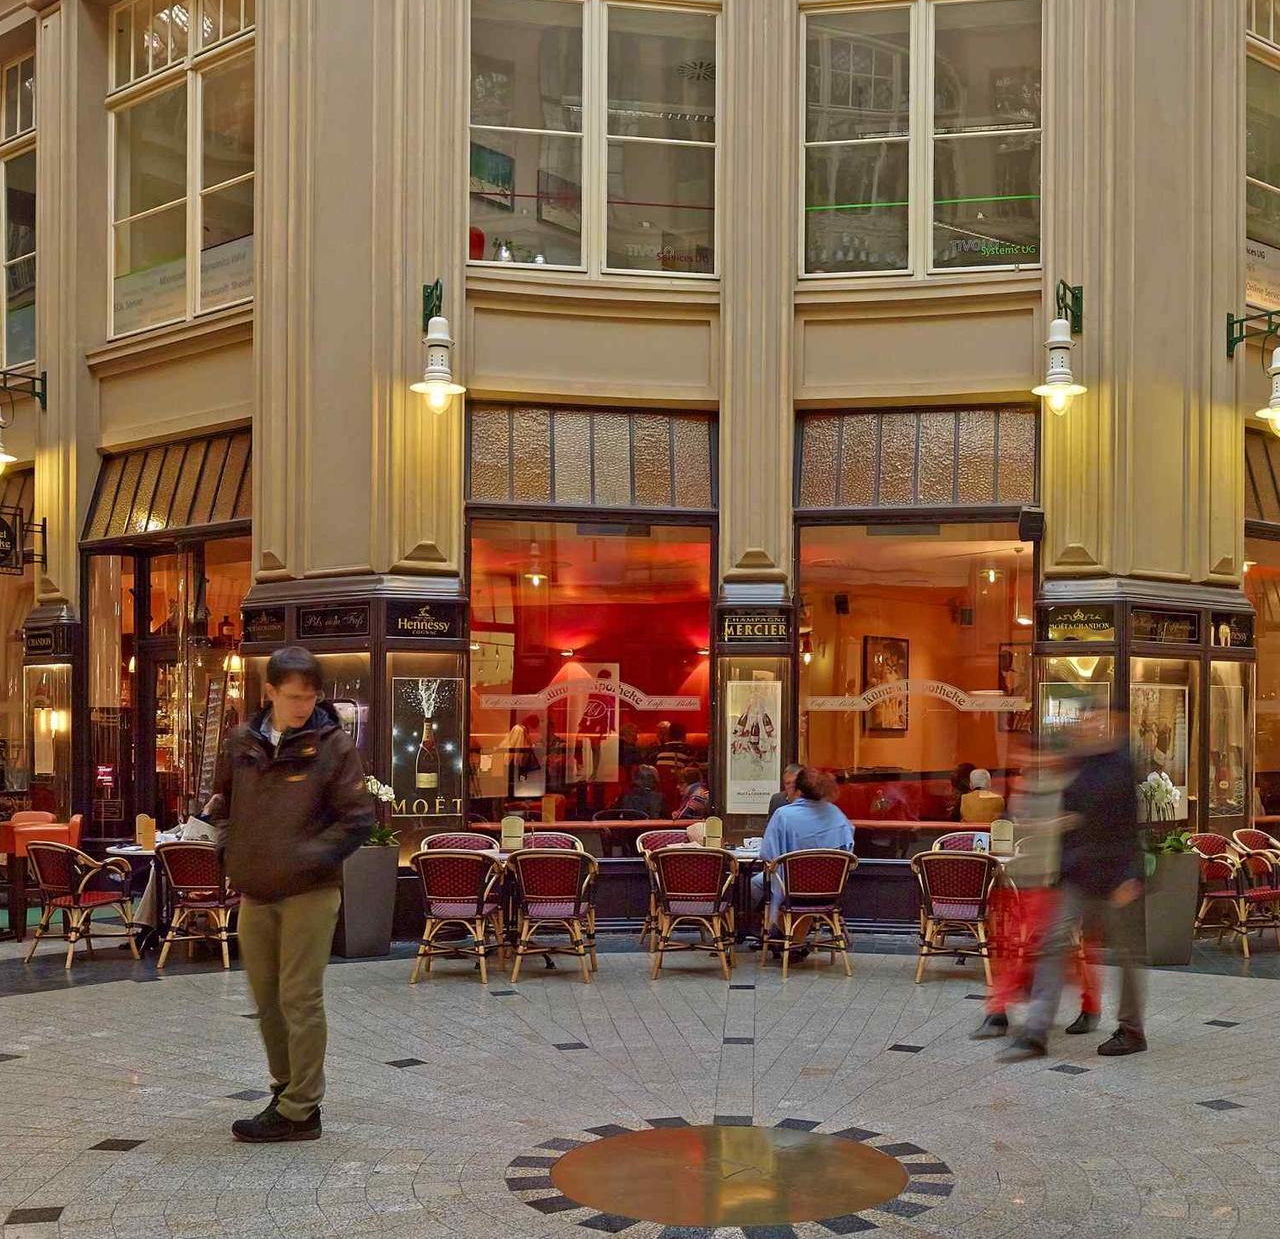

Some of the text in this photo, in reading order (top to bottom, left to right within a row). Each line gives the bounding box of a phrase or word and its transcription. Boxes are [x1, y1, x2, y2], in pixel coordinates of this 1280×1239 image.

[981, 245, 1036, 257] Systems UG
[398, 618, 450, 632] Hennessy
[724, 624, 787, 636] MERCIER
[391, 796, 463, 815] MOËT
